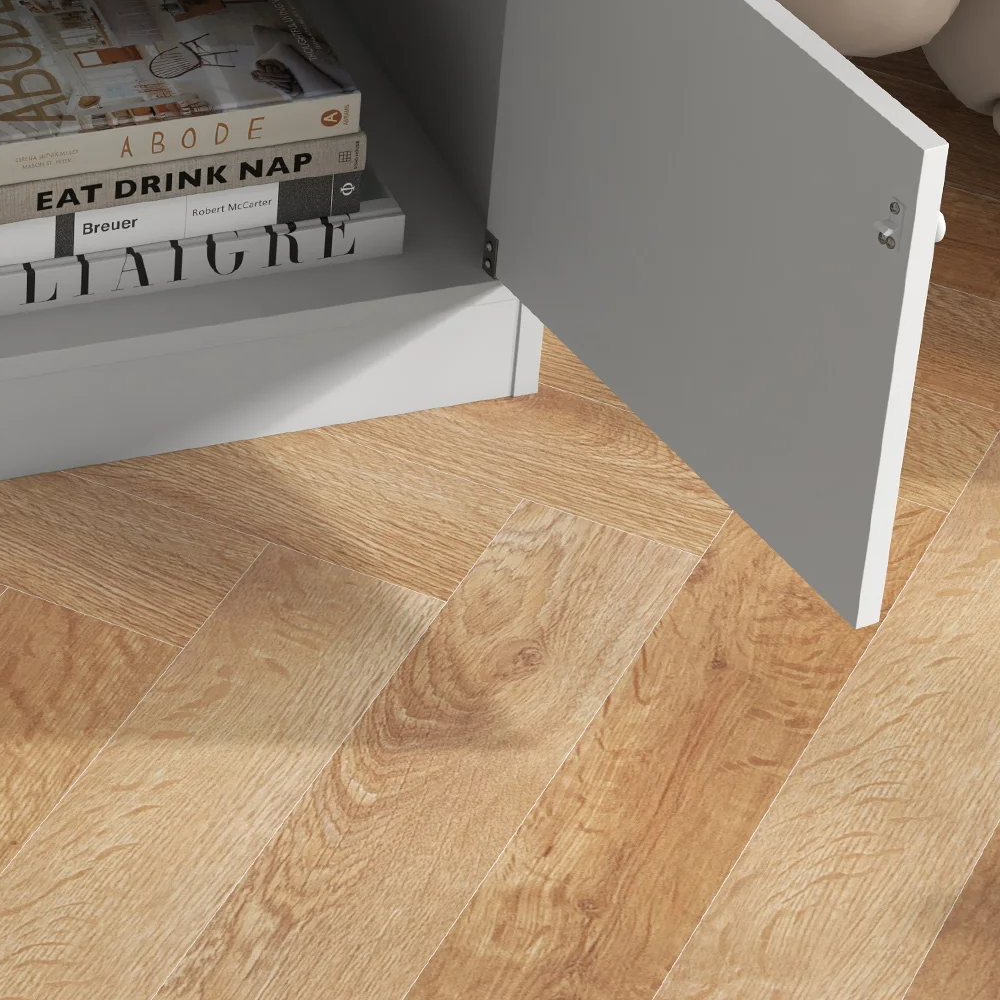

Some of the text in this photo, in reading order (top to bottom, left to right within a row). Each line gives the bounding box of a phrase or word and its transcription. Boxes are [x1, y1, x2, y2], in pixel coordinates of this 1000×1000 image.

[120, 117, 267, 159] ABODE
[36, 152, 313, 212] EAT DRINK NAP
[192, 198, 273, 217] Robert McCarter
[82, 215, 138, 236] Breuer
